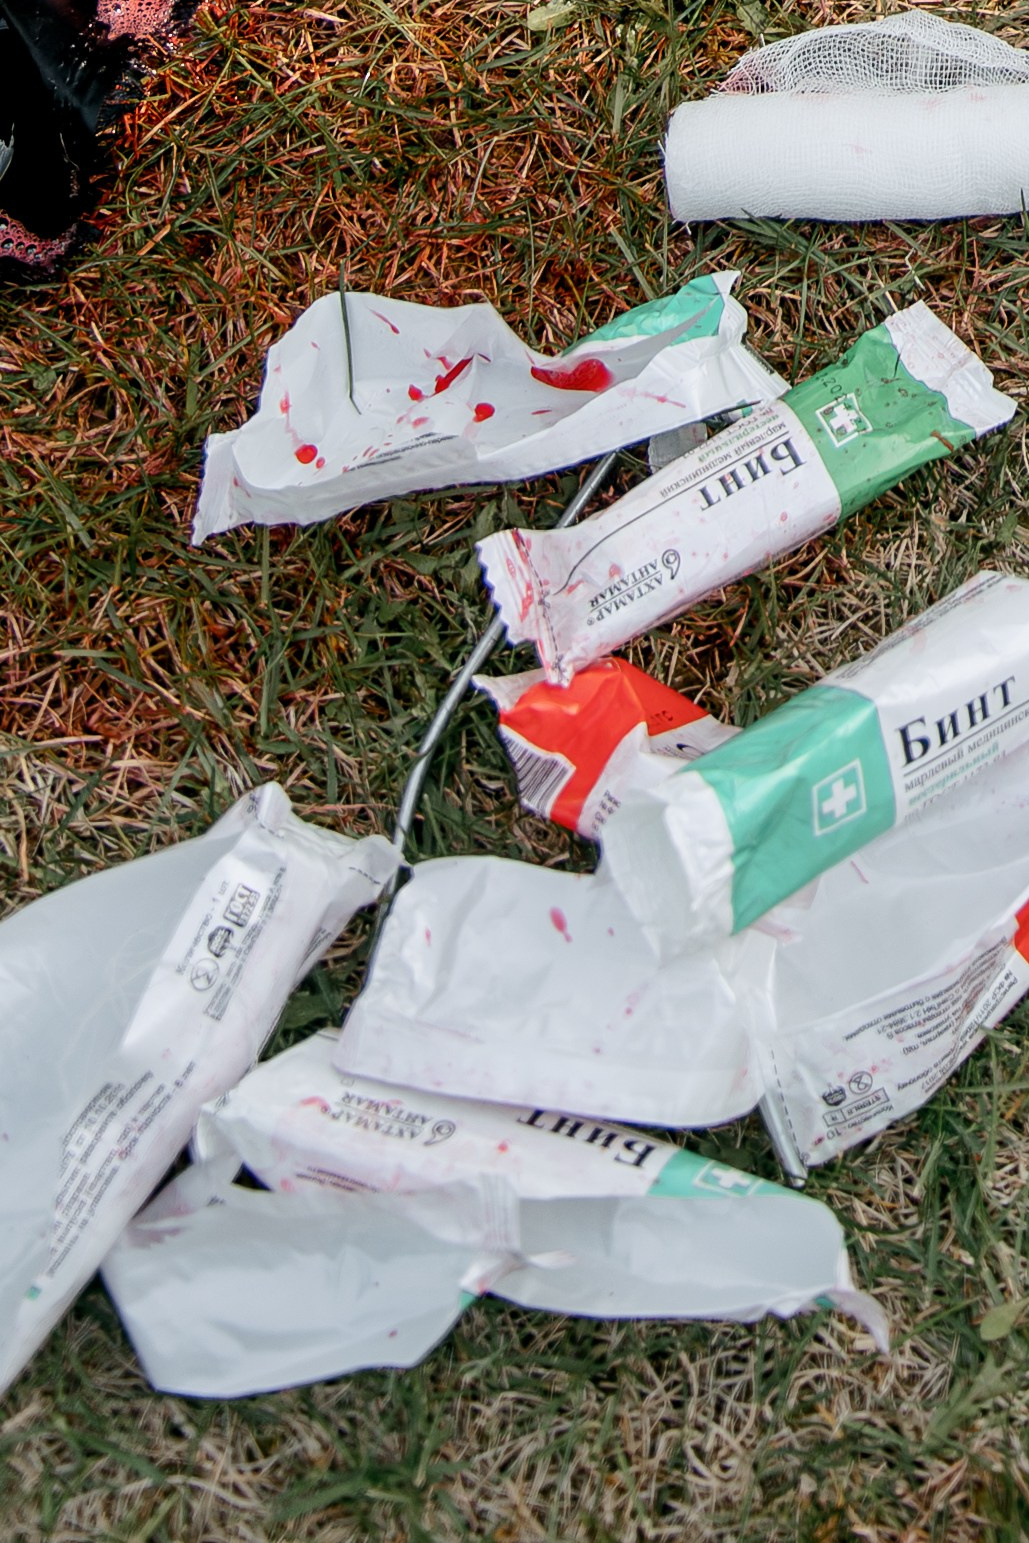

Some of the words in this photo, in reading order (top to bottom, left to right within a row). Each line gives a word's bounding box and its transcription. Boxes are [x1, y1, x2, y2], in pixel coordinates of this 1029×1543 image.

[732, 421, 787, 457] марлевый
[691, 435, 806, 512] Бинт
[897, 675, 1017, 767] Бинт
[903, 747, 966, 793] марлевый
[224, 883, 252, 923] ГОСТ
[515, 1106, 656, 1168] Бинт
